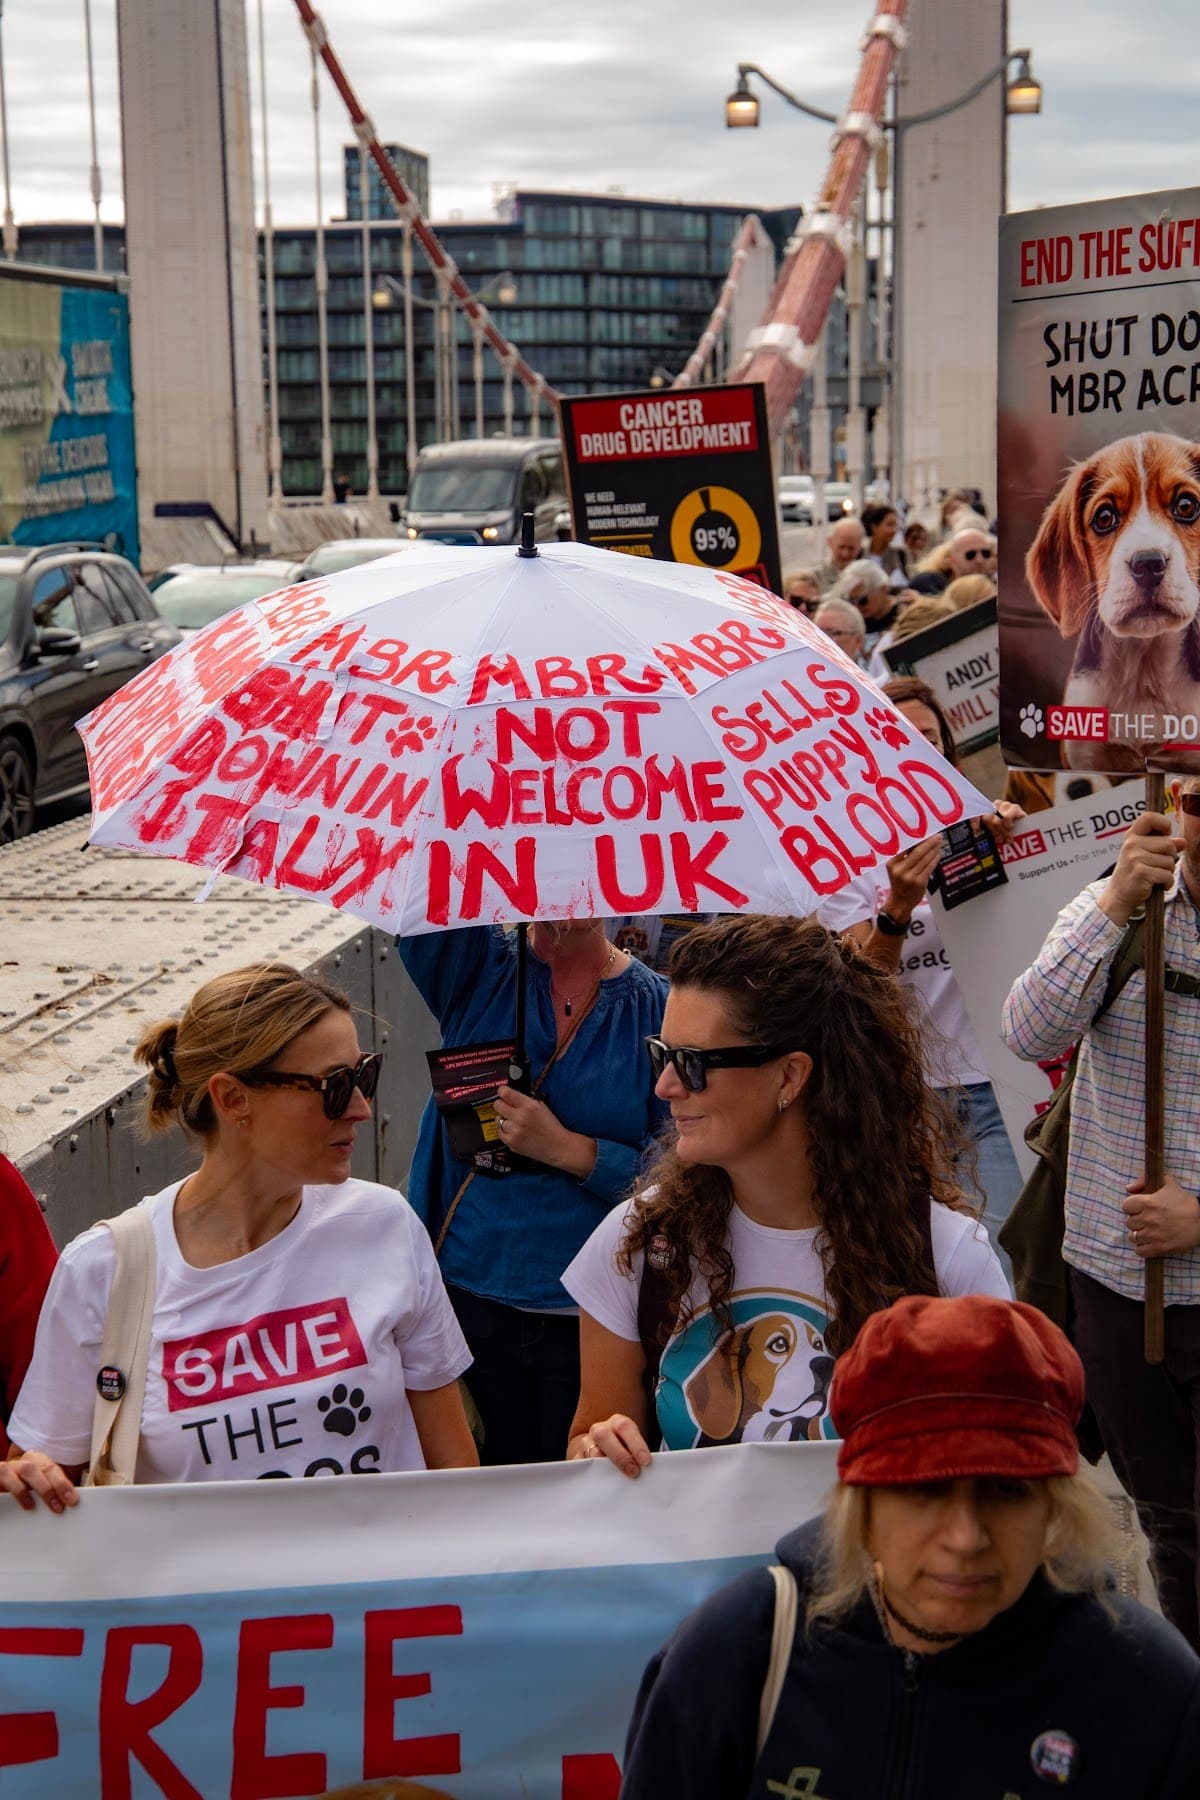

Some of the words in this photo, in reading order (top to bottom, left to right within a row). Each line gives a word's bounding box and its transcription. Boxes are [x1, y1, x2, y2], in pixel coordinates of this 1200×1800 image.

[1021, 235, 1073, 287] END
[1079, 227, 1133, 280] THE
[1043, 315, 1138, 368] SHUT
[1152, 310, 1200, 357] DO
[620, 398, 704, 431] CANCER
[1051, 369, 1127, 416] MBR
[580, 431, 626, 458] DRUG
[630, 421, 752, 454] DEVELOPMENT
[694, 526, 736, 551] 95%
[290, 623, 457, 693] MBR
[467, 653, 668, 705] MBR
[652, 620, 786, 696] MBR
[945, 653, 992, 691] ANDY
[496, 700, 662, 764] NOT
[711, 664, 861, 762] SELLS
[944, 695, 992, 731] WILL
[1051, 711, 1104, 737] SAVE
[1110, 714, 1155, 739] THE
[1163, 714, 1198, 740] DO
[441, 753, 745, 830] WELCOME
[743, 717, 881, 831] PUPPY
[780, 760, 964, 896] BLOOD
[999, 834, 1042, 862] AVE
[1044, 820, 1087, 846] THE
[1089, 801, 1147, 833] DOGS
[425, 837, 538, 926] IN
[595, 831, 749, 913] UK
[1018, 861, 1055, 880] Support
[1057, 860, 1068, 870] Us
[173, 1312, 350, 1398] SAVE
[182, 1398, 303, 1465] THE
